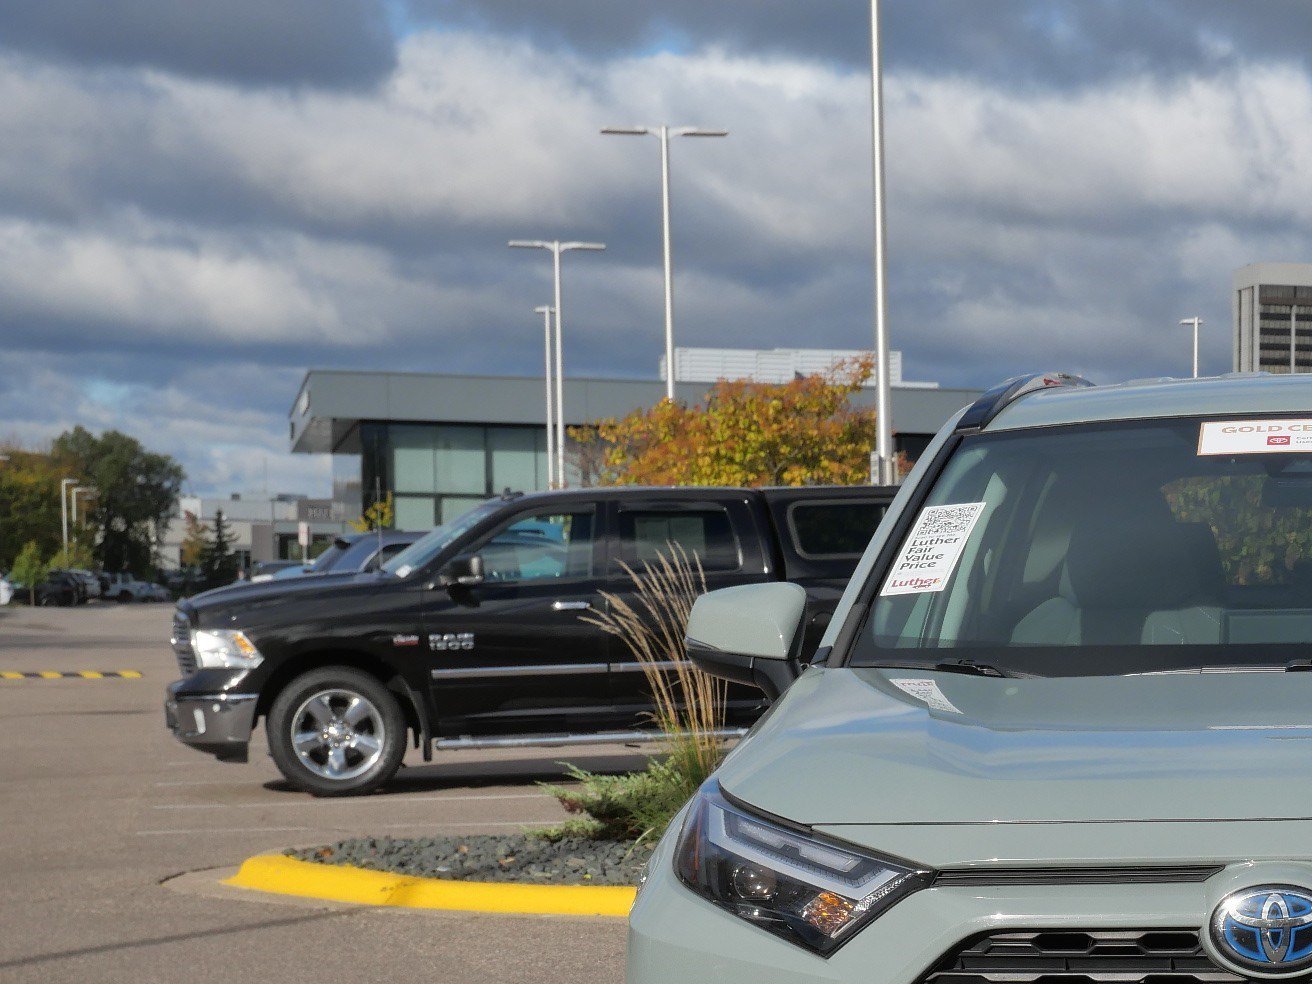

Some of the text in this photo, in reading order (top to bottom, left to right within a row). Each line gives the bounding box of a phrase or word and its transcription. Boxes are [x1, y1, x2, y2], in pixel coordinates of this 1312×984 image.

[1221, 425, 1283, 434] GOLD
[911, 536, 961, 547] Luther
[907, 546, 935, 555] Fair
[904, 553, 945, 561] Value
[899, 561, 937, 570] Price
[891, 577, 941, 588] Luther
